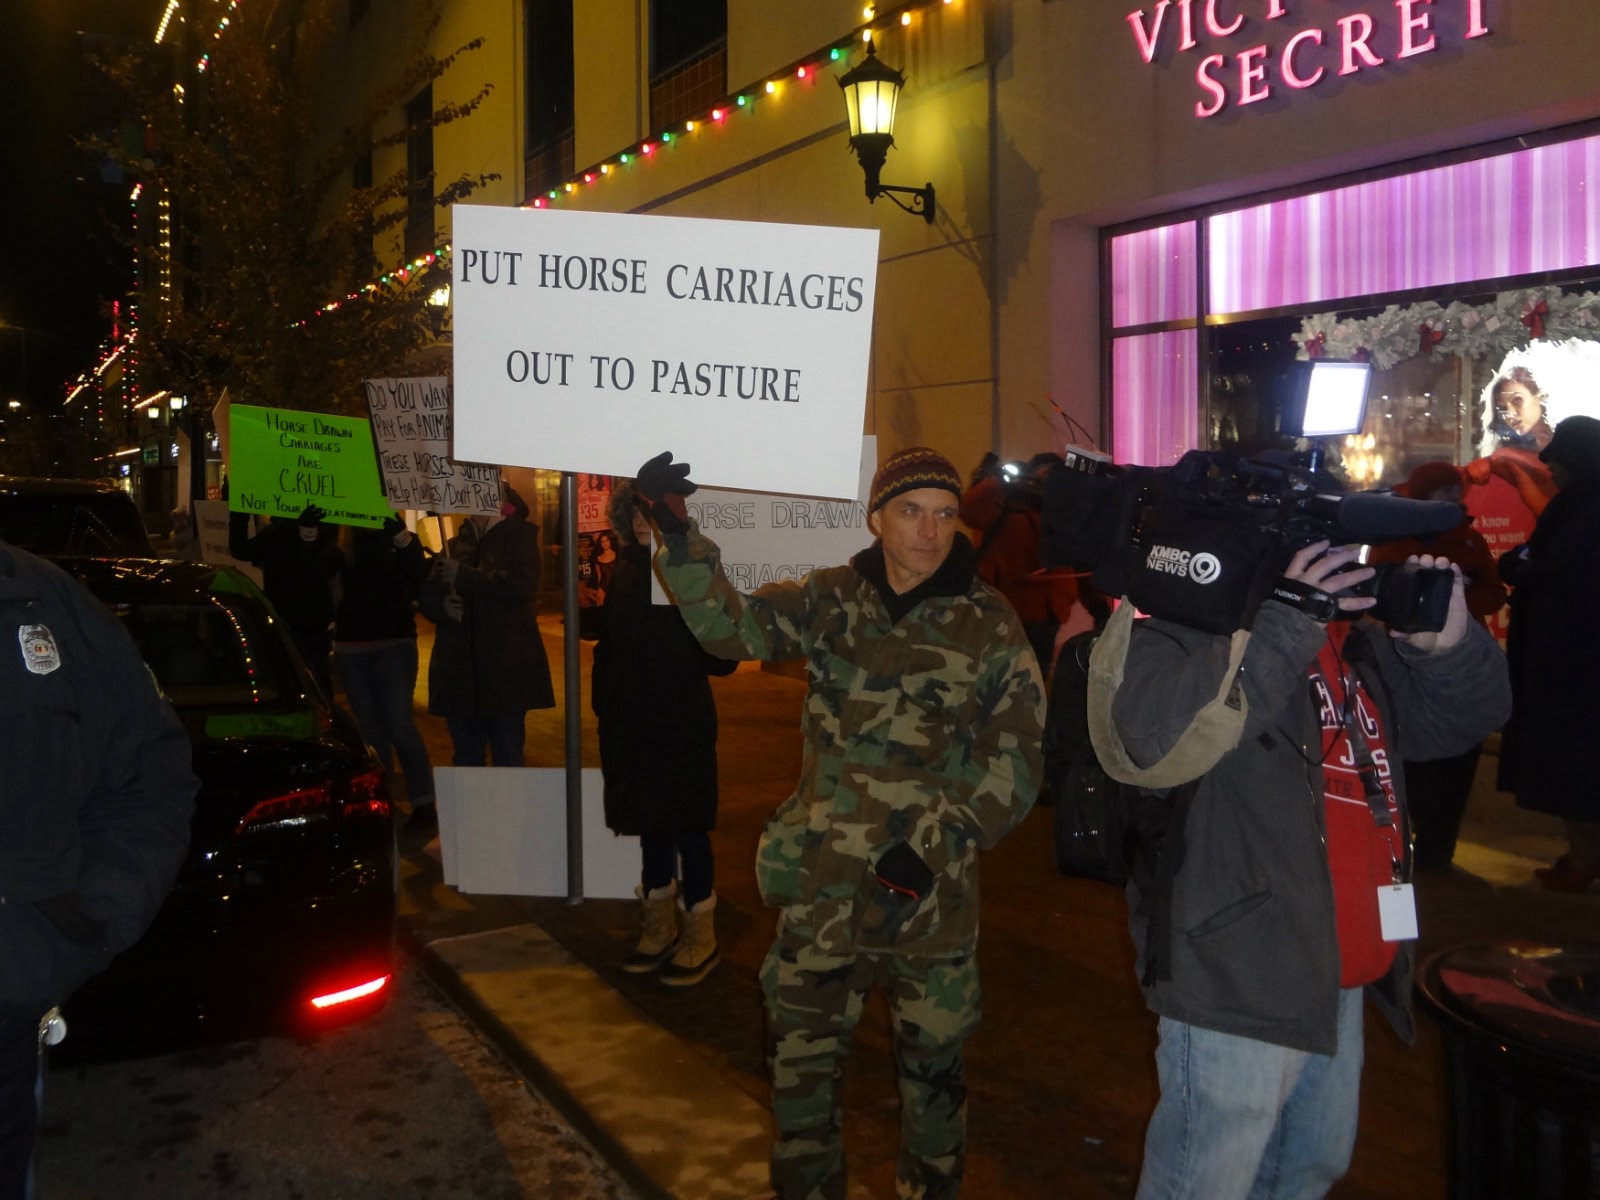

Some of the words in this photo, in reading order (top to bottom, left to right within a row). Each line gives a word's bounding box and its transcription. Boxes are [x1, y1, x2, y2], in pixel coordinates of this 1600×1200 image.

[461, 249, 522, 286] PUT
[538, 254, 648, 294] HORSE
[666, 264, 864, 312] CARRIAGES
[506, 350, 574, 386] OUT
[590, 355, 635, 390] TO
[650, 359, 801, 402] PASTURE
[387, 379, 416, 410] YOU
[419, 382, 450, 408] WAN
[266, 412, 308, 433] HORSE
[313, 418, 353, 438] DRAWN
[374, 413, 396, 439] PAY
[416, 413, 450, 438] ANIMA
[279, 433, 341, 453] CARRIAGES
[297, 454, 323, 469] ARE
[380, 450, 411, 470] THESE
[413, 451, 454, 476] HORSES
[279, 468, 346, 498] CRUEL
[687, 502, 755, 529] ORSE
[771, 501, 868, 528] DRAWN
[1481, 515, 1510, 528] know
[1150, 544, 1191, 564] KMBC
[1146, 556, 1188, 578] NEWS
[1189, 552, 1221, 584] 9
